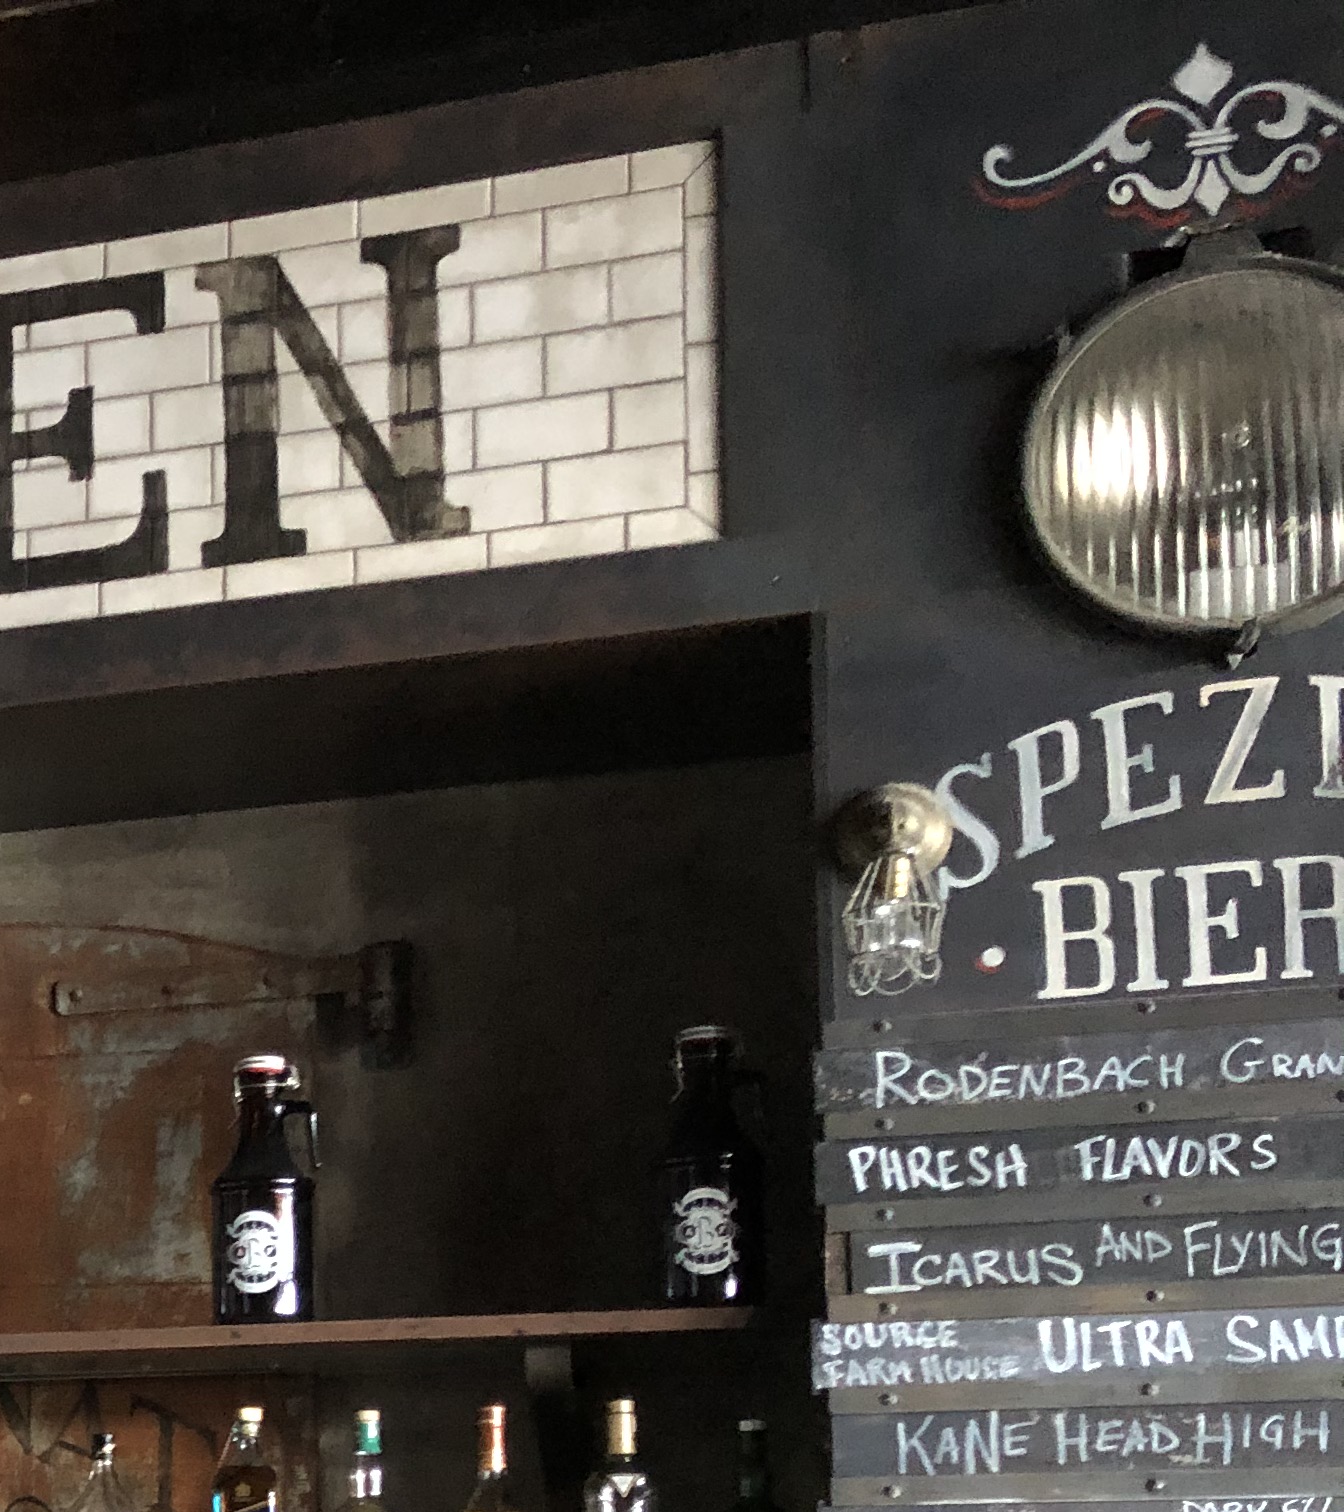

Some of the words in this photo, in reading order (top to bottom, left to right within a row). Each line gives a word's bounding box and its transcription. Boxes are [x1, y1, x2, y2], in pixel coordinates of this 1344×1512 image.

[1032, 854, 1344, 1000] BIER
[875, 1051, 1186, 1108] RODENBACH
[848, 1144, 1028, 1193] PHRESH
[1074, 1133, 1278, 1182] FLAVORS
[864, 1240, 1084, 1294] ICARUS
[1095, 1222, 1173, 1267] AND
[1183, 1220, 1343, 1278] FLYING
[815, 1356, 914, 1389] FARM
[919, 1354, 1020, 1384] HOUSE
[820, 1320, 960, 1356] SOURCE
[1037, 1317, 1194, 1374] ULTRA
[896, 1410, 1041, 1476] KANE
